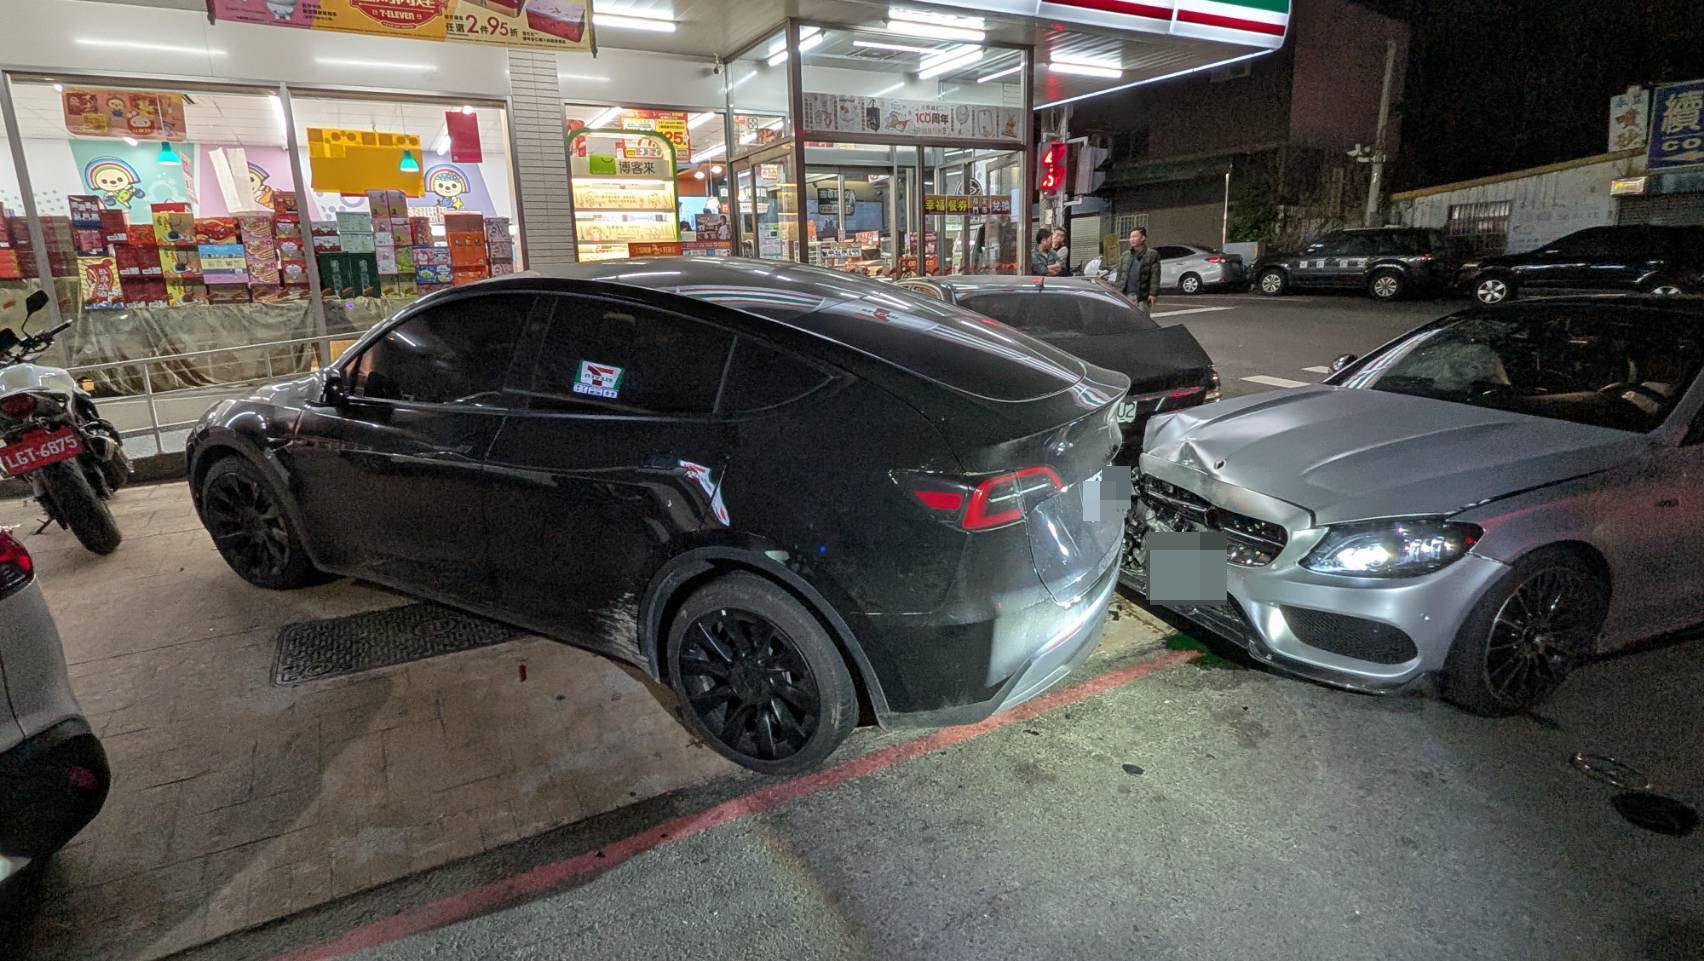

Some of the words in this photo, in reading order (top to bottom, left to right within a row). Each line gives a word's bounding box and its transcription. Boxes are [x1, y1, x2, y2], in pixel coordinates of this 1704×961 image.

[618, 160, 656, 175] 博客來
[5, 434, 78, 468] LGT-6875
